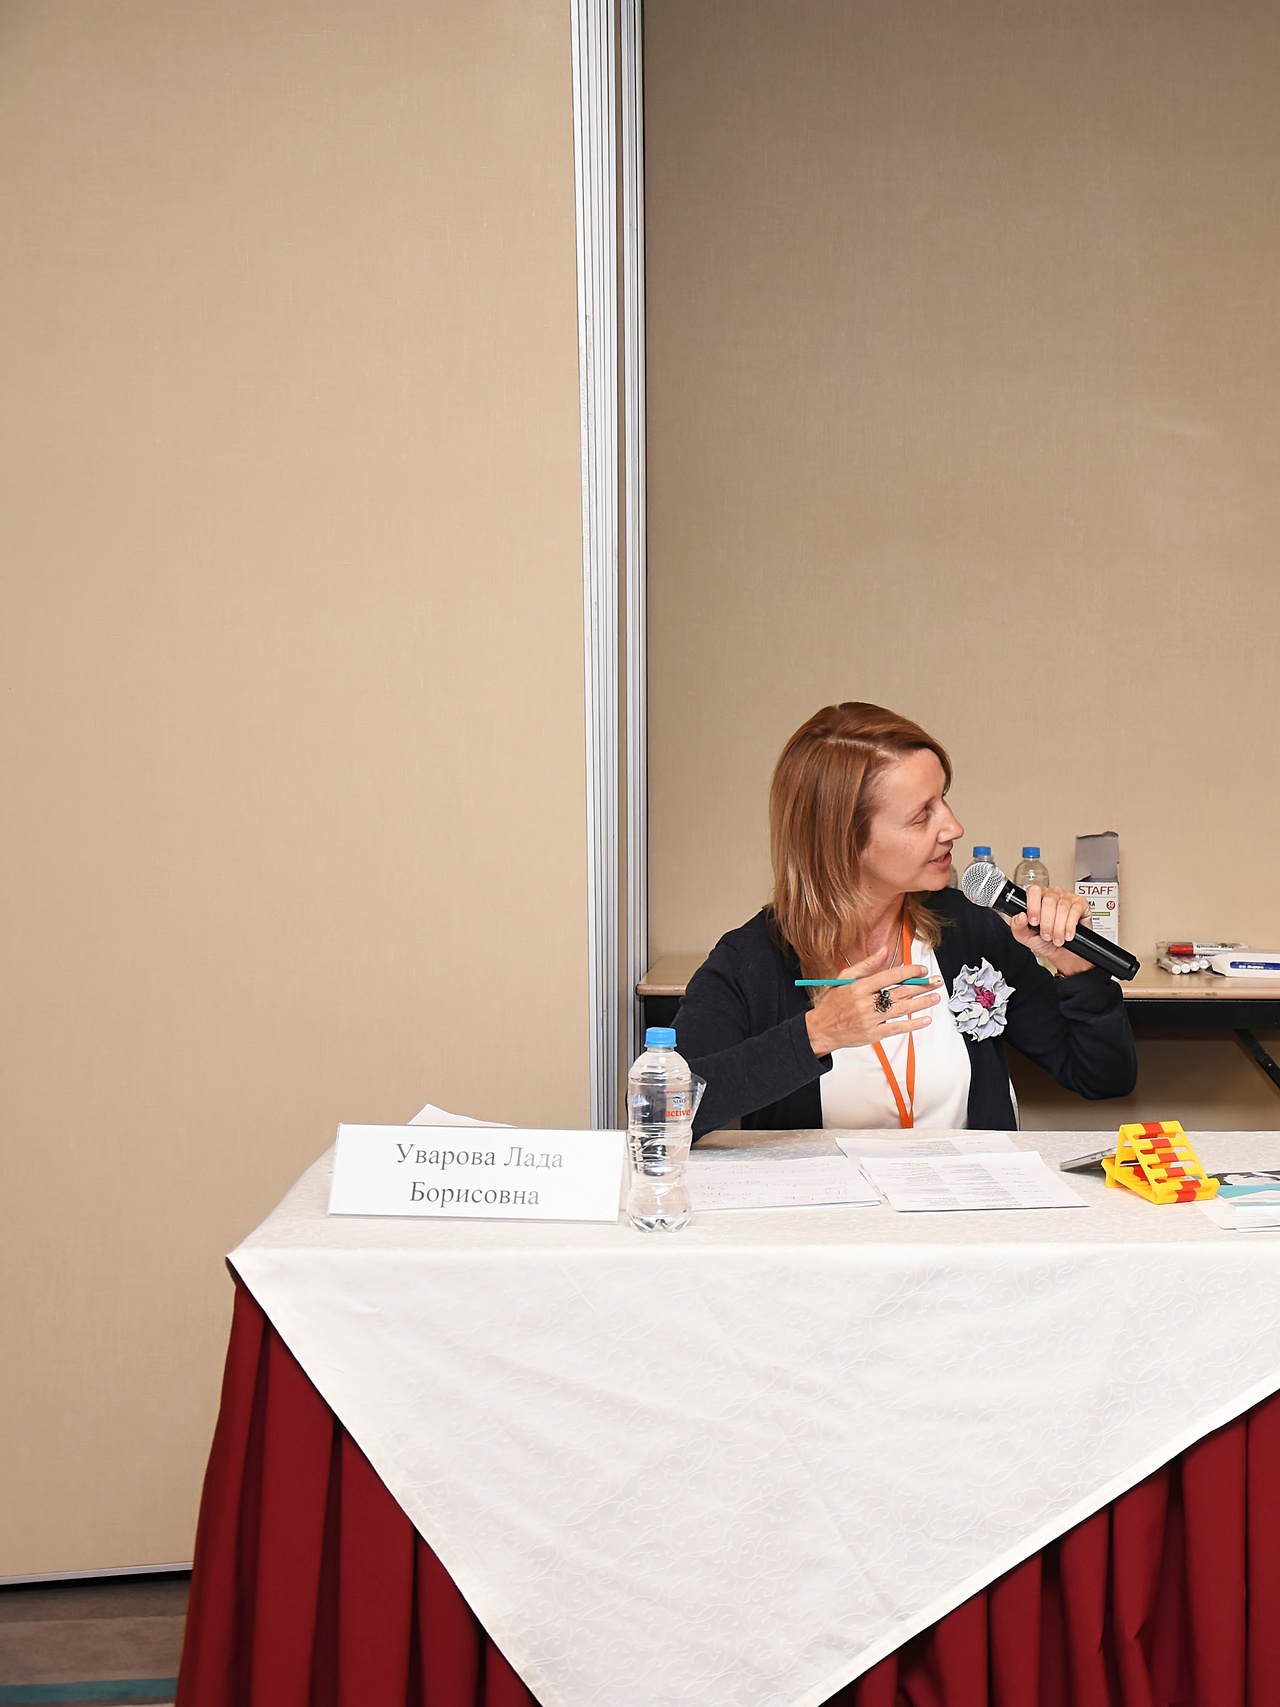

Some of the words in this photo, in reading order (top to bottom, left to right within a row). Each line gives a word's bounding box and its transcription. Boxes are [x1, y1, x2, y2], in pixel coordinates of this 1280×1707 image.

[1078, 885, 1114, 895] STAFF
[665, 1108, 691, 1118] active
[396, 1143, 495, 1170] Уварова
[504, 1146, 564, 1168] Лада
[410, 1181, 540, 1208] Борисовна
